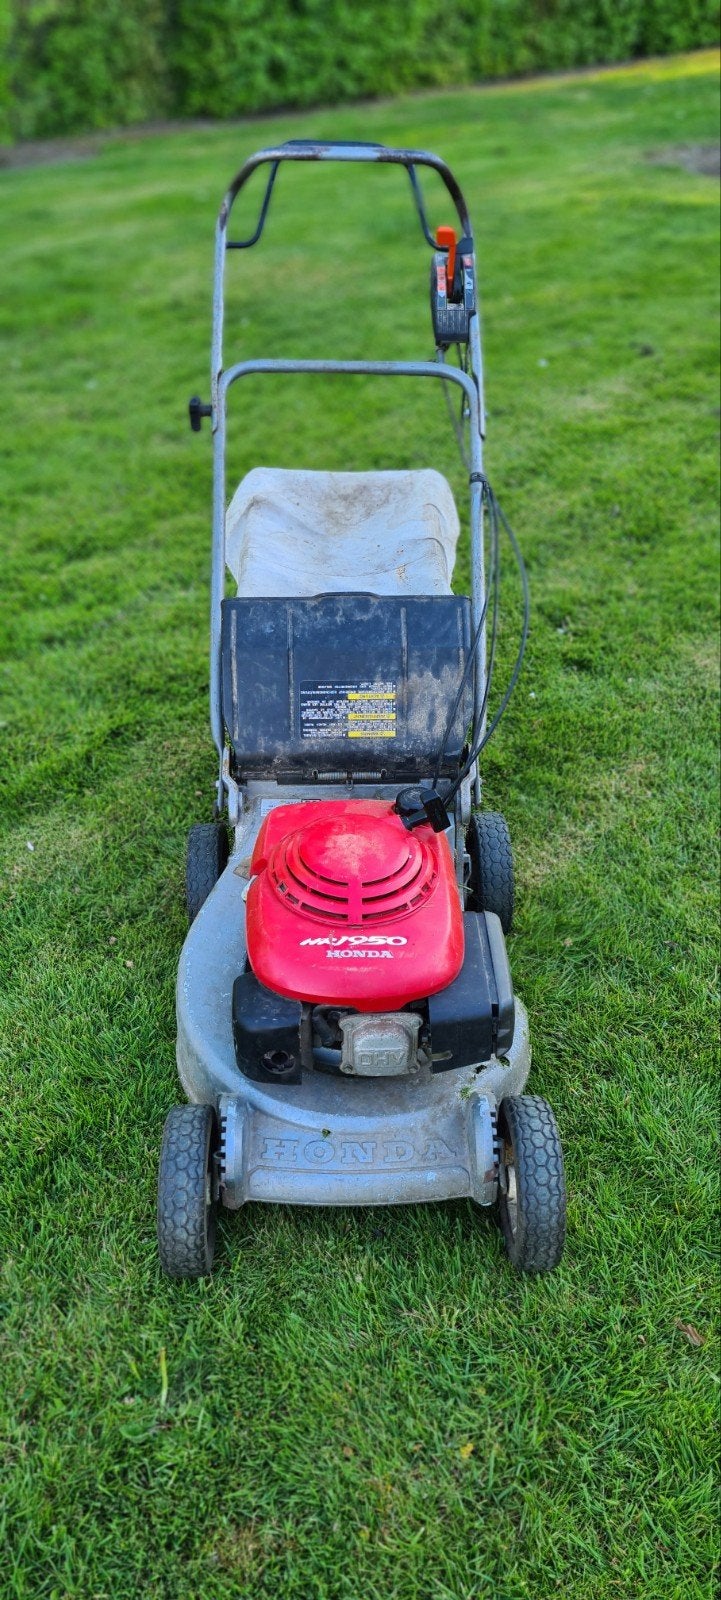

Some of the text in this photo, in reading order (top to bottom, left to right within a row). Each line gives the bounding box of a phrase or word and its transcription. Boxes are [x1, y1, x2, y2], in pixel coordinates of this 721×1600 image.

[326, 950, 394, 959] HONDA
[358, 1051, 406, 1067] OHV
[261, 1137, 457, 1164] HONDA
